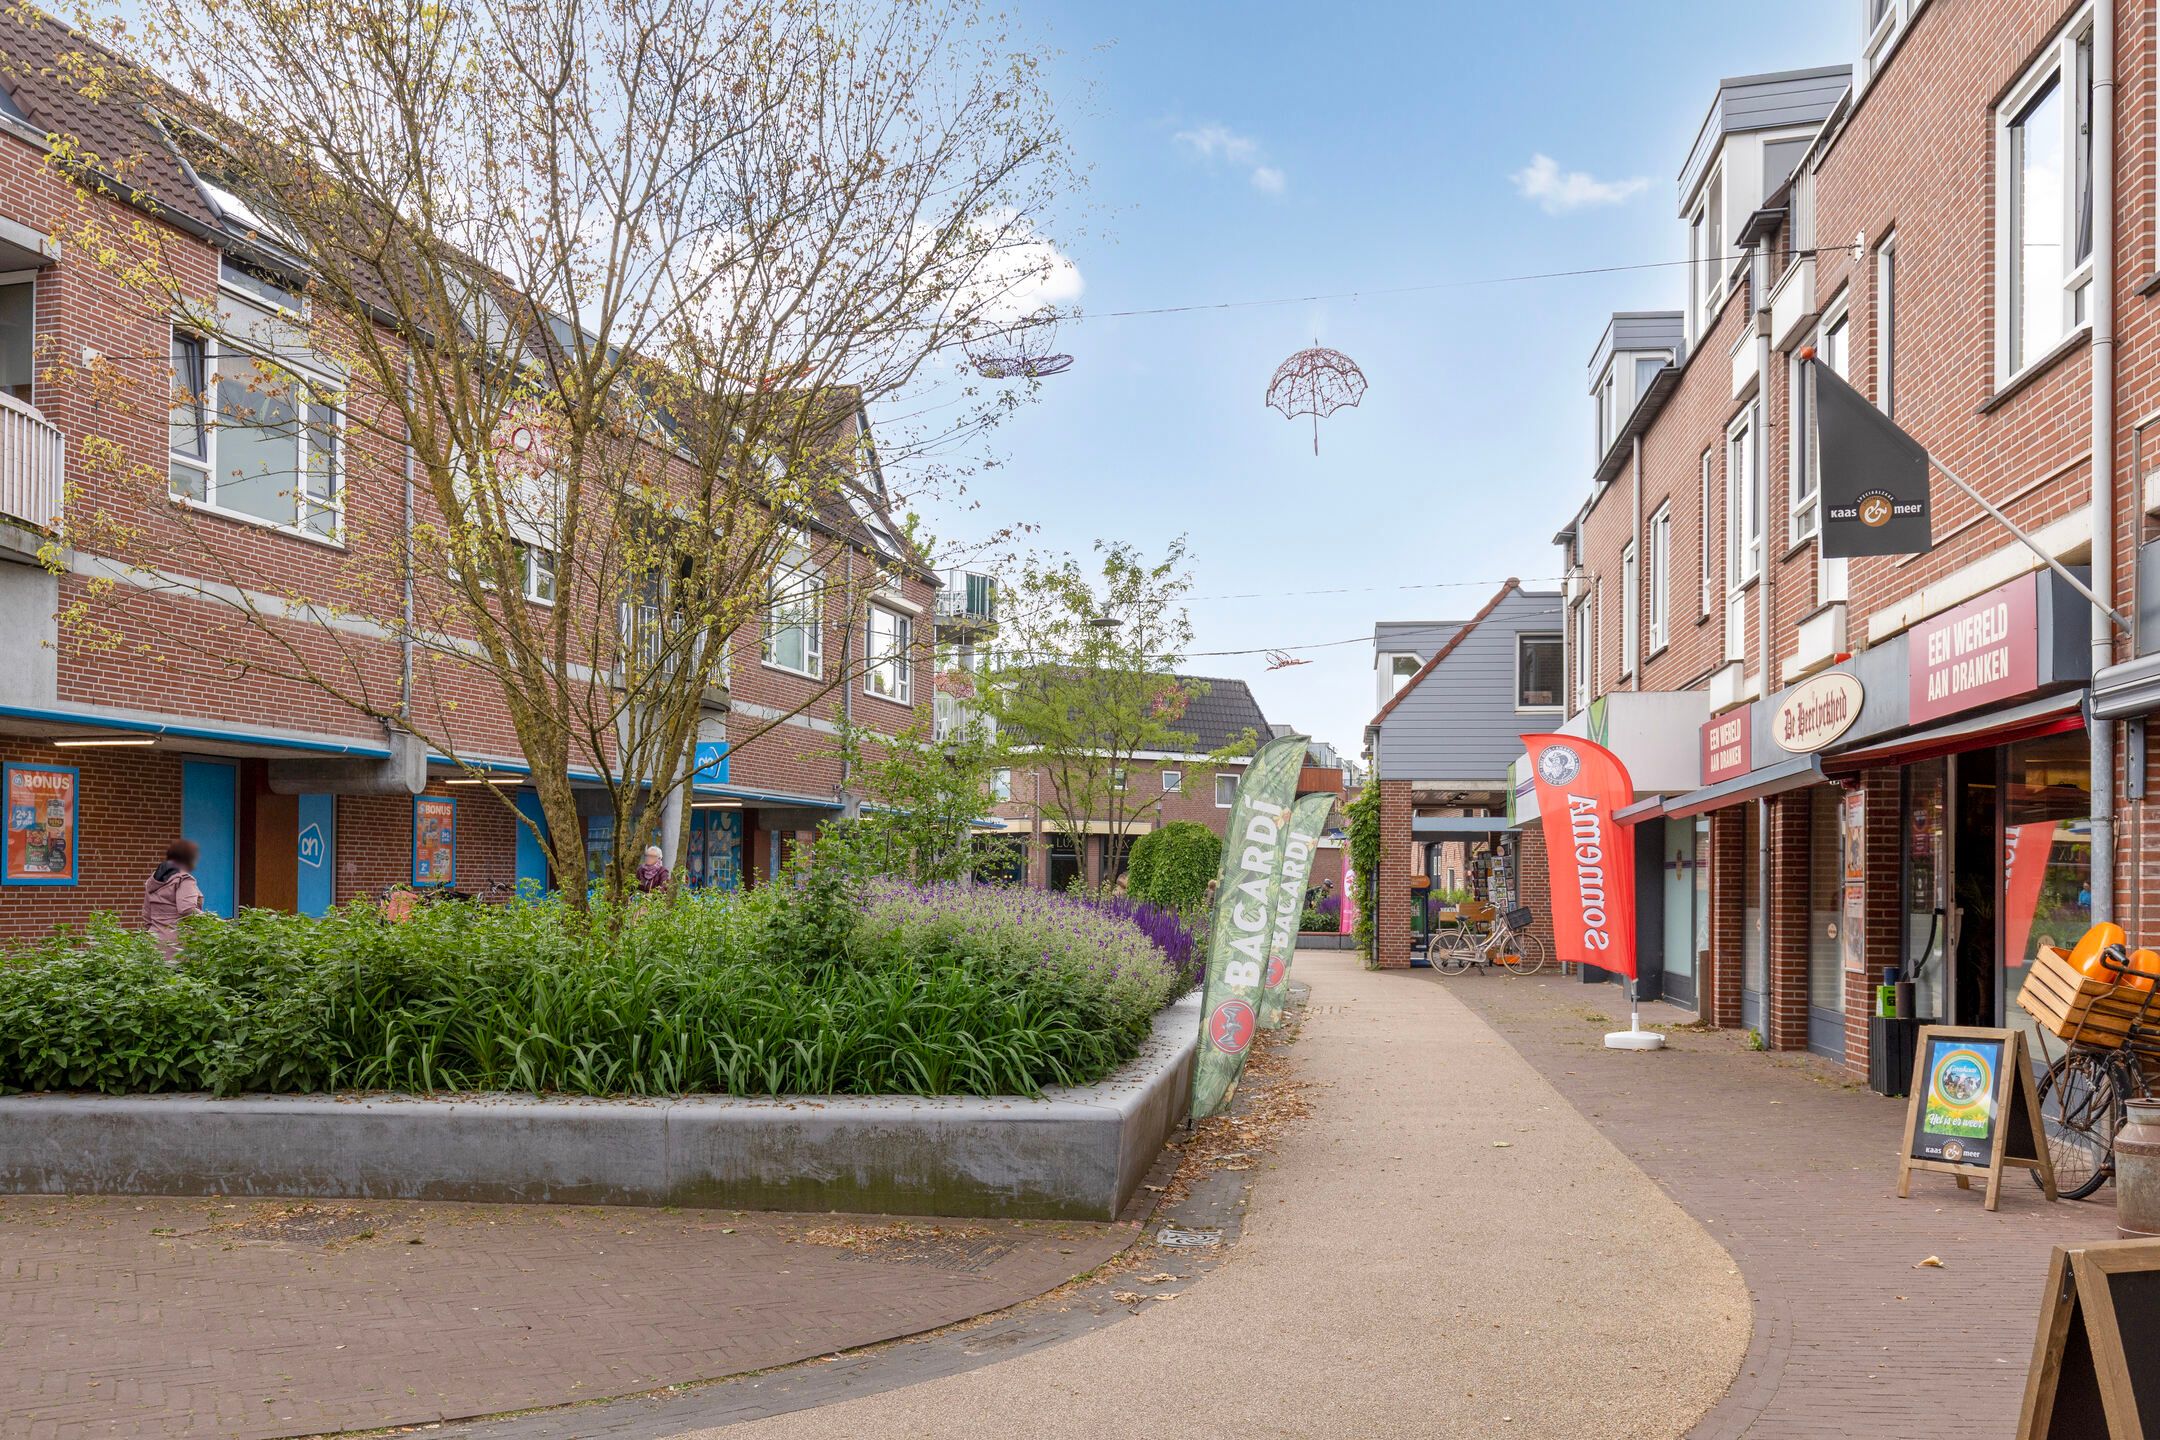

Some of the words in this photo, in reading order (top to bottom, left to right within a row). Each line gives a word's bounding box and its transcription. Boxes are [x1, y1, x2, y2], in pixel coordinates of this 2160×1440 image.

[1894, 504, 1922, 514] meer
[1928, 626, 1951, 667] EEN
[1953, 602, 2009, 657] WERELD
[1927, 667, 1949, 702] AAN
[1952, 646, 2009, 694] DRANKEN
[1710, 727, 1720, 751] EEN
[1720, 718, 1741, 747] WERELD
[1784, 708, 1795, 742] De
[1710, 752, 1720, 772] AAN
[1720, 745, 1742, 770] DRANKEN
[24, 774, 70, 790] BONUS
[425, 805, 451, 816] BONUS
[1963, 1150, 1981, 1158] meer
